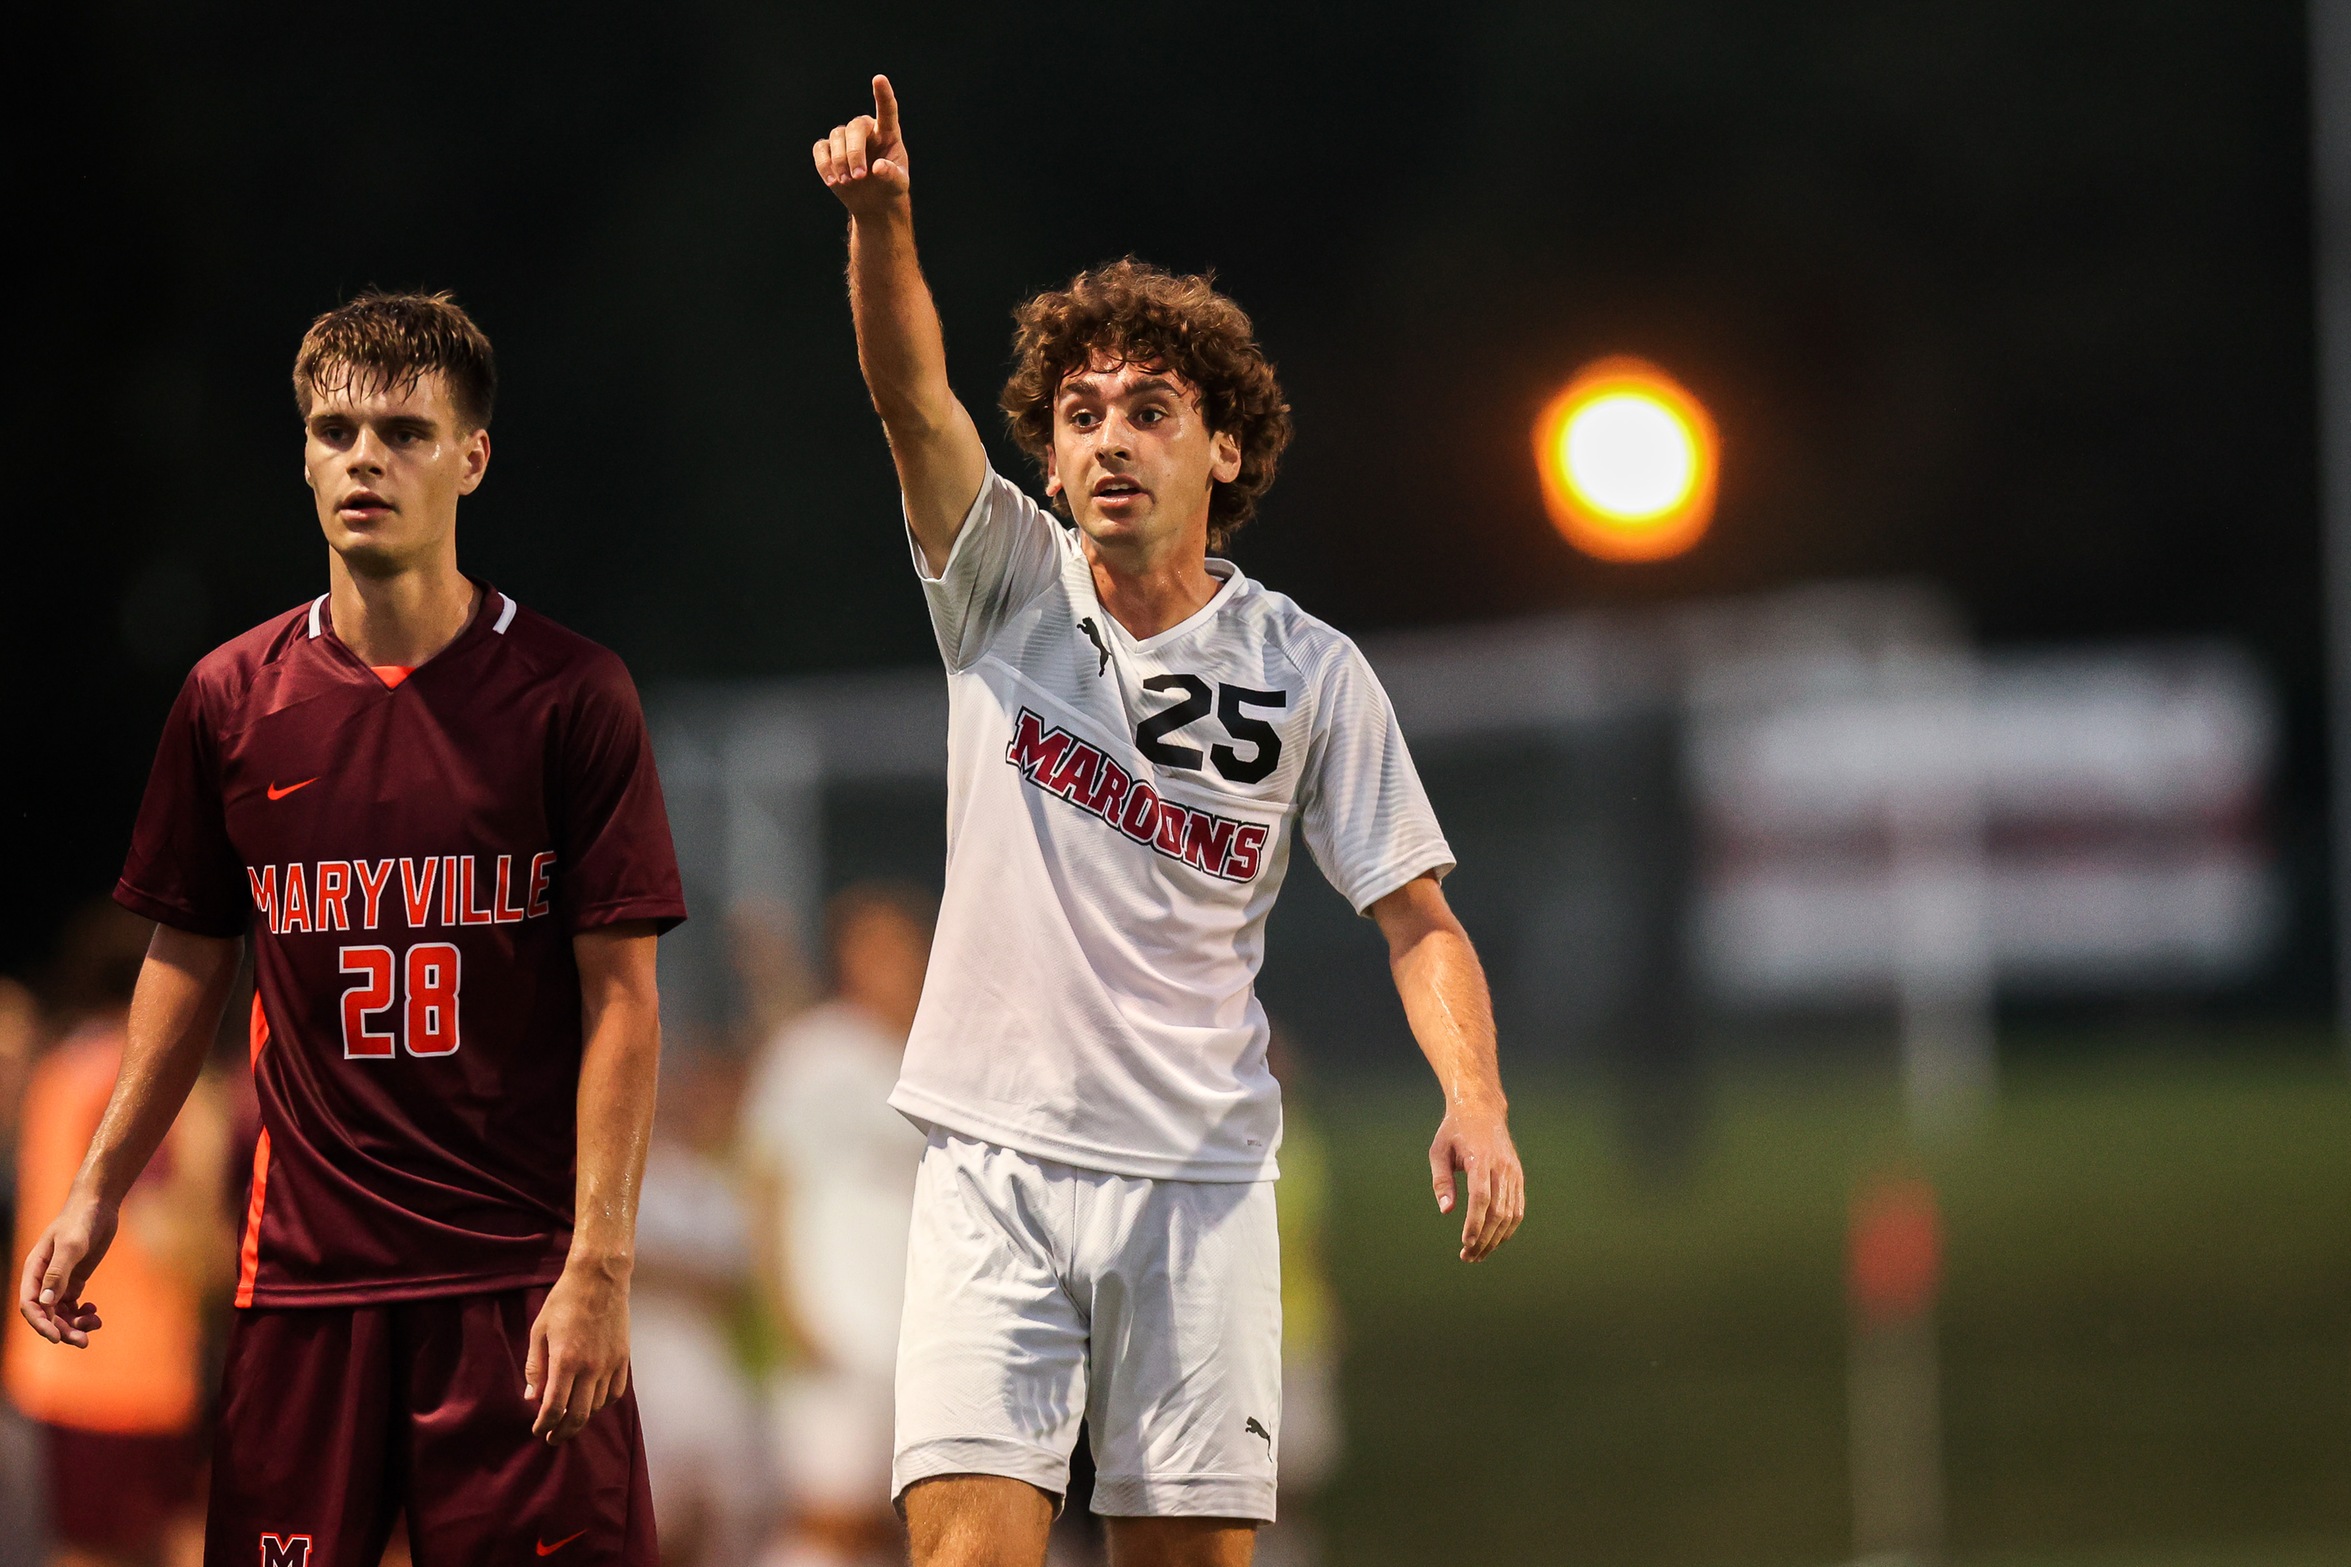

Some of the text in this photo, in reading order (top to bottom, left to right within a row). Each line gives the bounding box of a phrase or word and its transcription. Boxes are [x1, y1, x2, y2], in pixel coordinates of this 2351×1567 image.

[1135, 674, 1287, 784] 25
[1005, 705, 1270, 883] MAROONS
[247, 850, 558, 934] MARYVILLE
[339, 942, 461, 1059] 28
[260, 1532, 312, 1567] M
